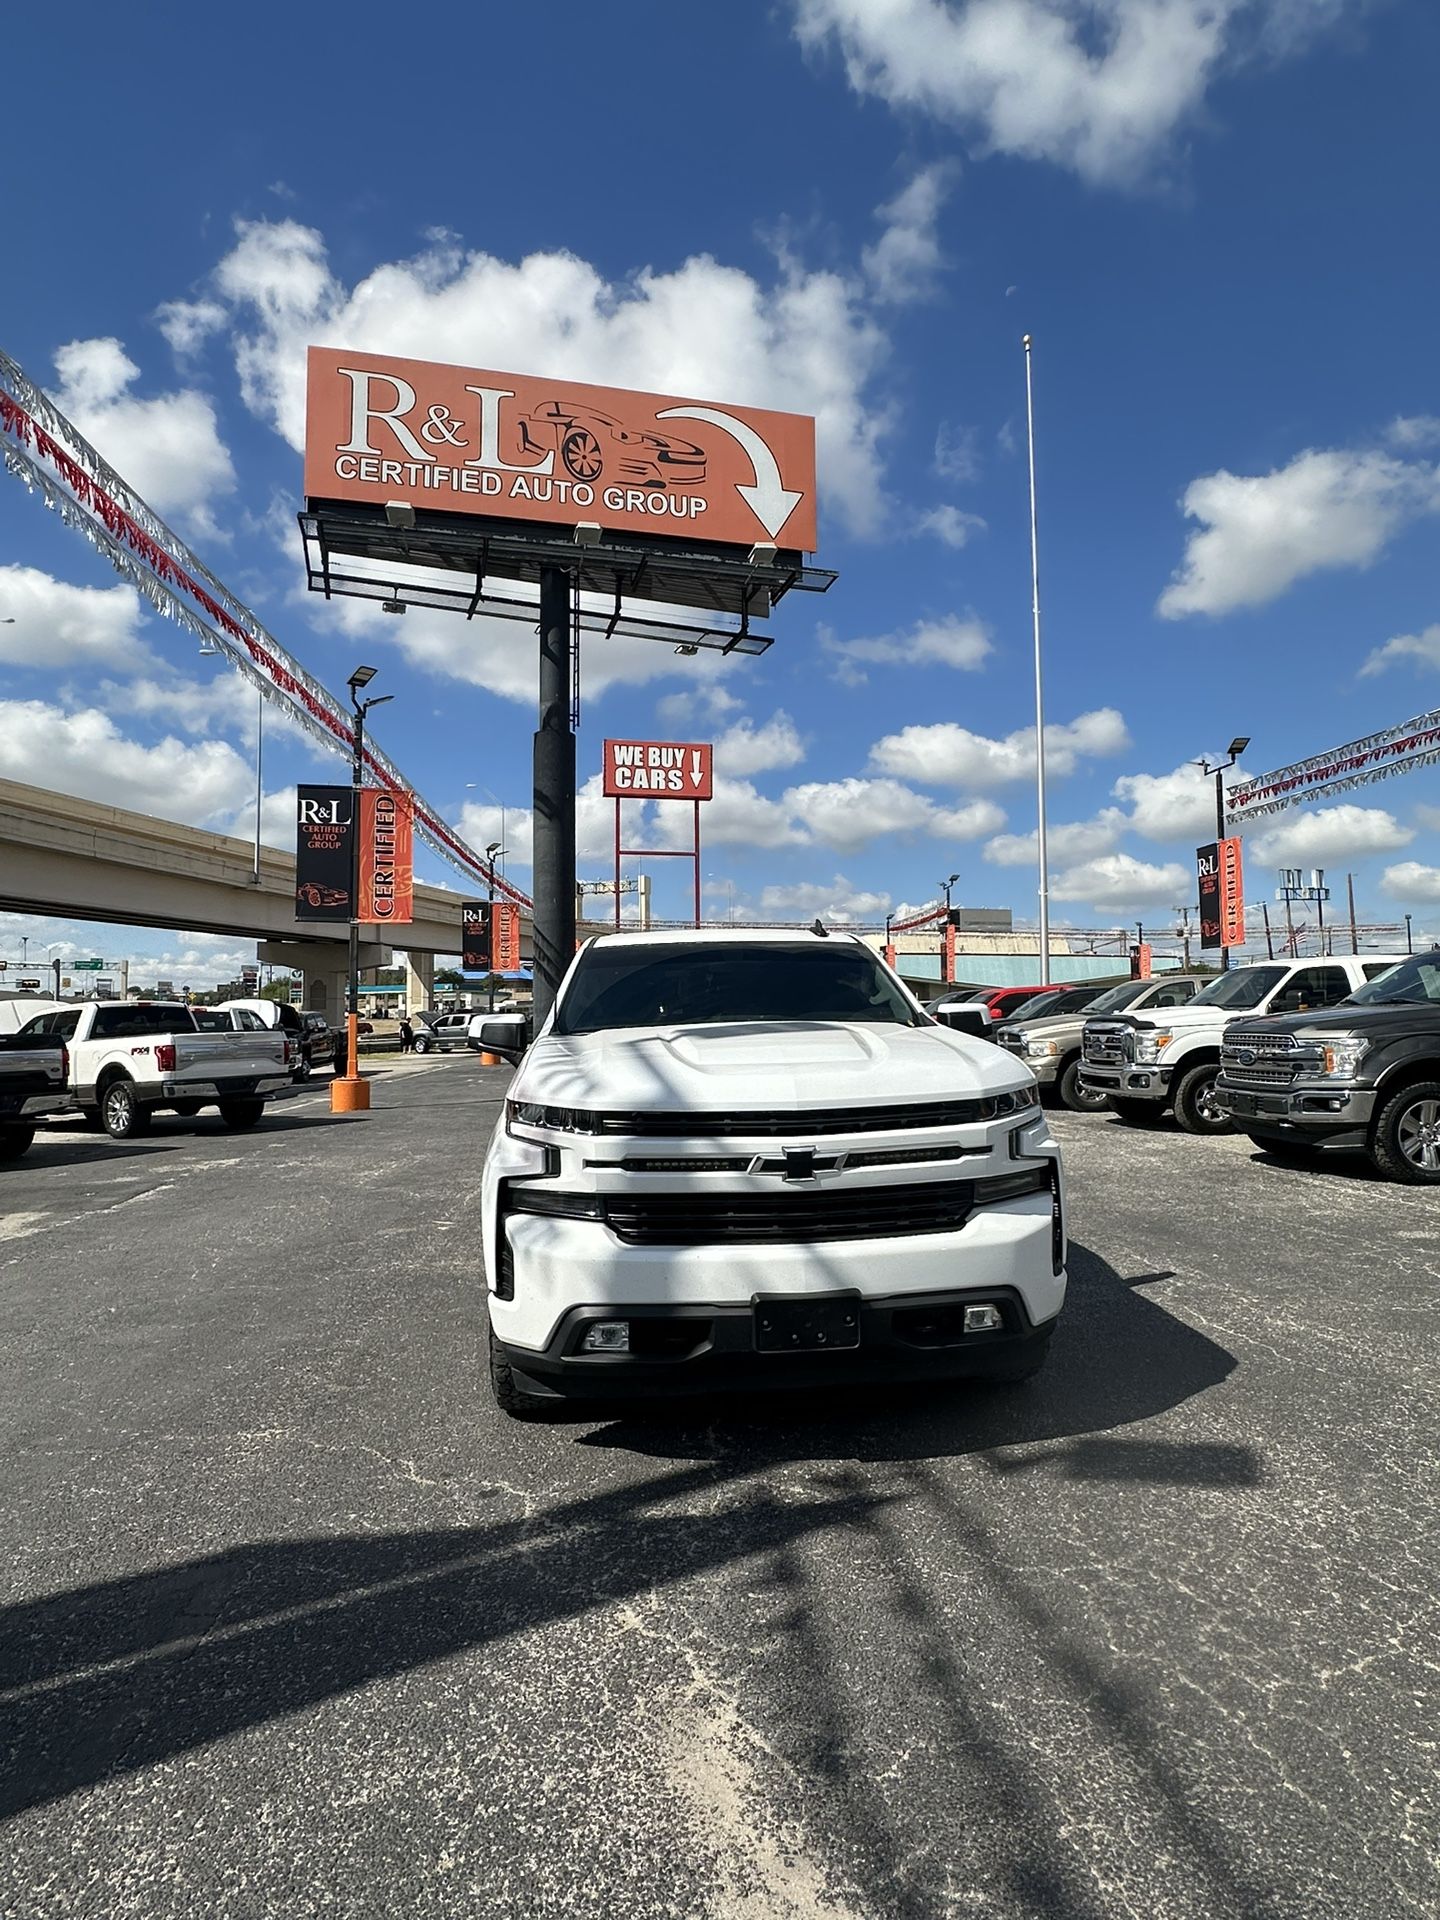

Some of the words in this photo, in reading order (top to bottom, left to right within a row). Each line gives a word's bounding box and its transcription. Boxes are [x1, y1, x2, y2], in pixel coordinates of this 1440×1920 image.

[336, 367, 556, 476] R&L
[335, 454, 503, 497] CERTIFIED
[509, 475, 595, 507] AUTO
[602, 487, 708, 519] GROUP
[613, 744, 644, 767] WE
[648, 747, 686, 768] BUY
[614, 767, 685, 791] CARS
[298, 799, 351, 824] R&L
[302, 825, 347, 833] CERTIFIED
[307, 841, 341, 849] GROUP
[373, 794, 397, 918] CERTIFIED
[1198, 855, 1219, 877] R&L
[463, 909, 489, 923] R&L
[131, 1046, 150, 1056] FX4
